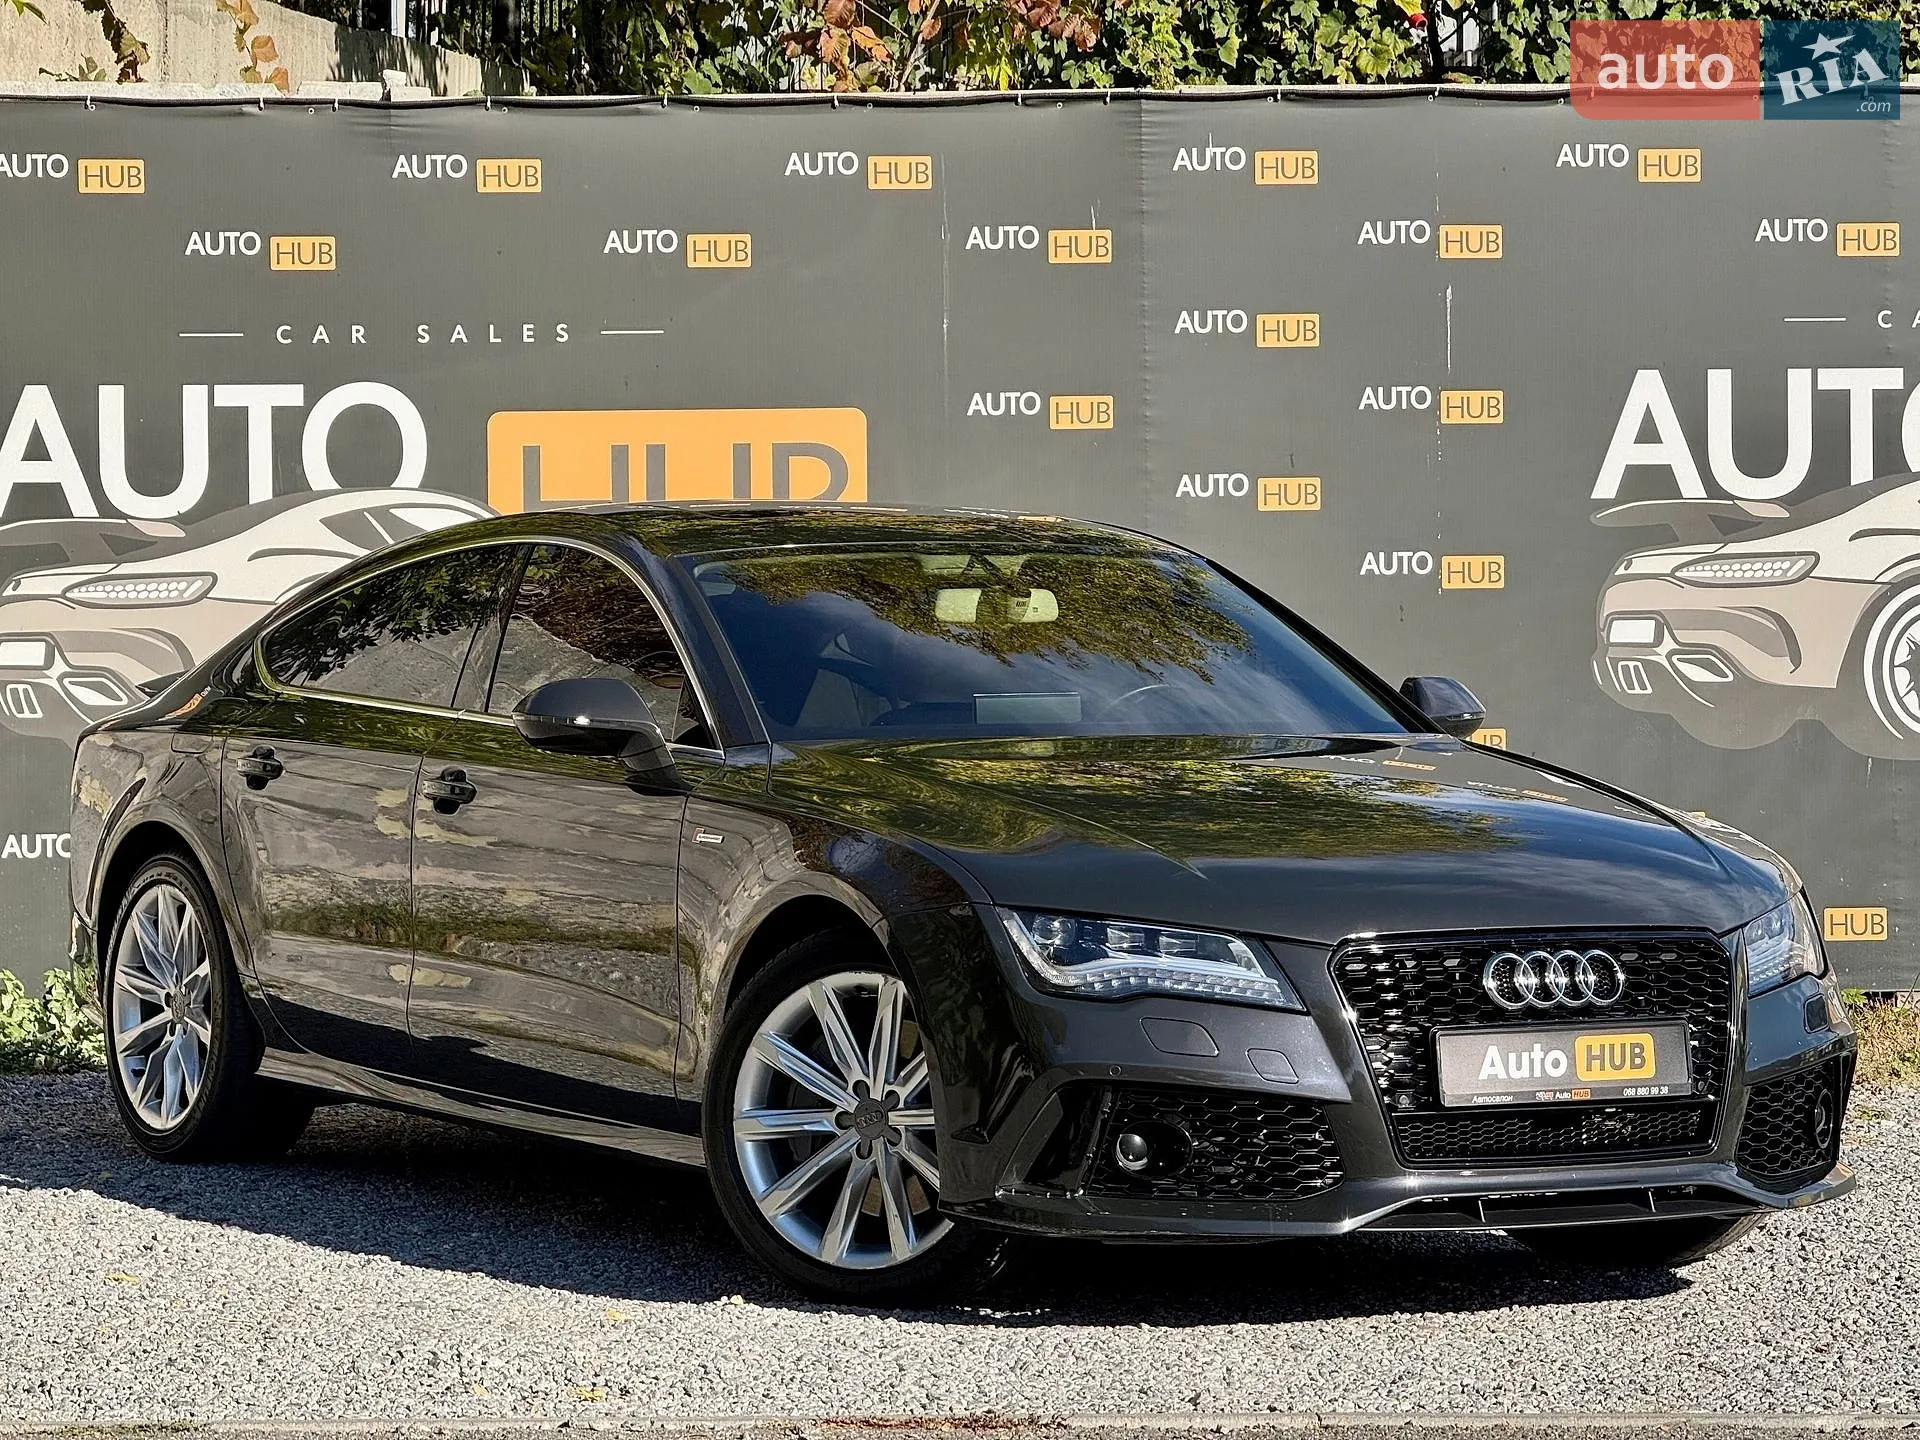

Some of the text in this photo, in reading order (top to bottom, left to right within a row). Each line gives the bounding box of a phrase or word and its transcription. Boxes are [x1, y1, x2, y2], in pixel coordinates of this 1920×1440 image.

[392, 155, 539, 187] AUTO HUB
[785, 152, 929, 184] AUTO HUB
[1173, 147, 1315, 179] AUTO HUB
[1556, 144, 1697, 176] AUTO HUB
[84, 165, 141, 188] HUB
[185, 232, 333, 264] AUTO HUB
[604, 230, 749, 262] AUTO HUB
[966, 226, 1109, 258] AUTO HUB
[1358, 220, 1499, 252] AUTO HUB
[1755, 219, 1896, 250] AUTO HUB
[276, 322, 570, 345] CAR SALES
[1175, 310, 1316, 342] AUTO HUB
[967, 392, 1111, 424] AUTO HUB
[1359, 386, 1501, 418] AUTO HUB
[0, 381, 427, 518] AUTO
[1591, 367, 1920, 501] AUT
[1176, 473, 1318, 505] AUTO HUB
[1360, 551, 1502, 583] AUTO HUB
[1830, 914, 1884, 935] HUB
[1478, 1042, 1647, 1080] Auto HUB
[1555, 1091, 1572, 1100] Auto
[1573, 1090, 1590, 1098] HUB
[1650, 1086, 1659, 1095] 99
[1660, 1085, 1669, 1095] 38
